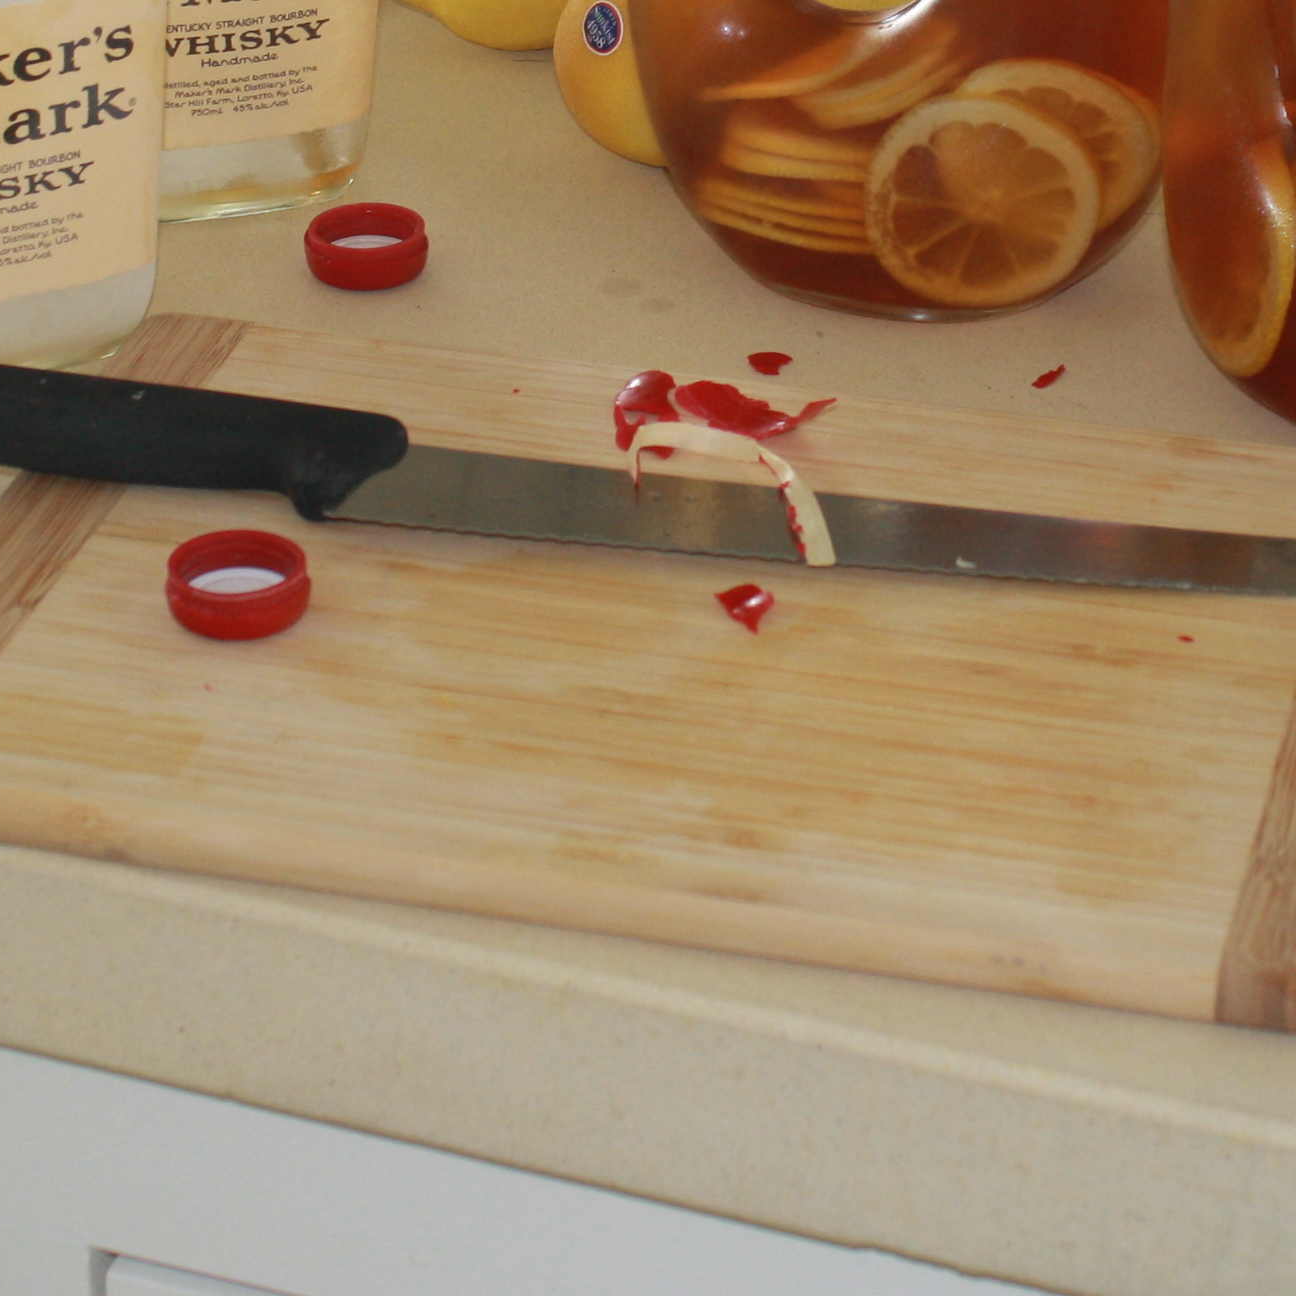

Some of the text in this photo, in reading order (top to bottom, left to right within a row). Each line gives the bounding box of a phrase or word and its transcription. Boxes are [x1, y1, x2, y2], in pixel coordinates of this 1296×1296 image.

[166, 8, 319, 35] ENTUCKY STRAIGHT BOURBON
[200, 52, 279, 68] Handmade
[203, 78, 228, 88] aged
[231, 74, 250, 83] and
[252, 70, 286, 82] bottled
[288, 68, 301, 78] by
[302, 65, 318, 73] the
[174, 89, 212, 99] Maker's
[188, 98, 204, 107] Hill
[292, 84, 314, 95] USA
[28, 150, 81, 169] BOURBON
[11, 219, 49, 232] bottled
[51, 215, 65, 226] by
[66, 212, 84, 221] the
[56, 233, 79, 245] USA
